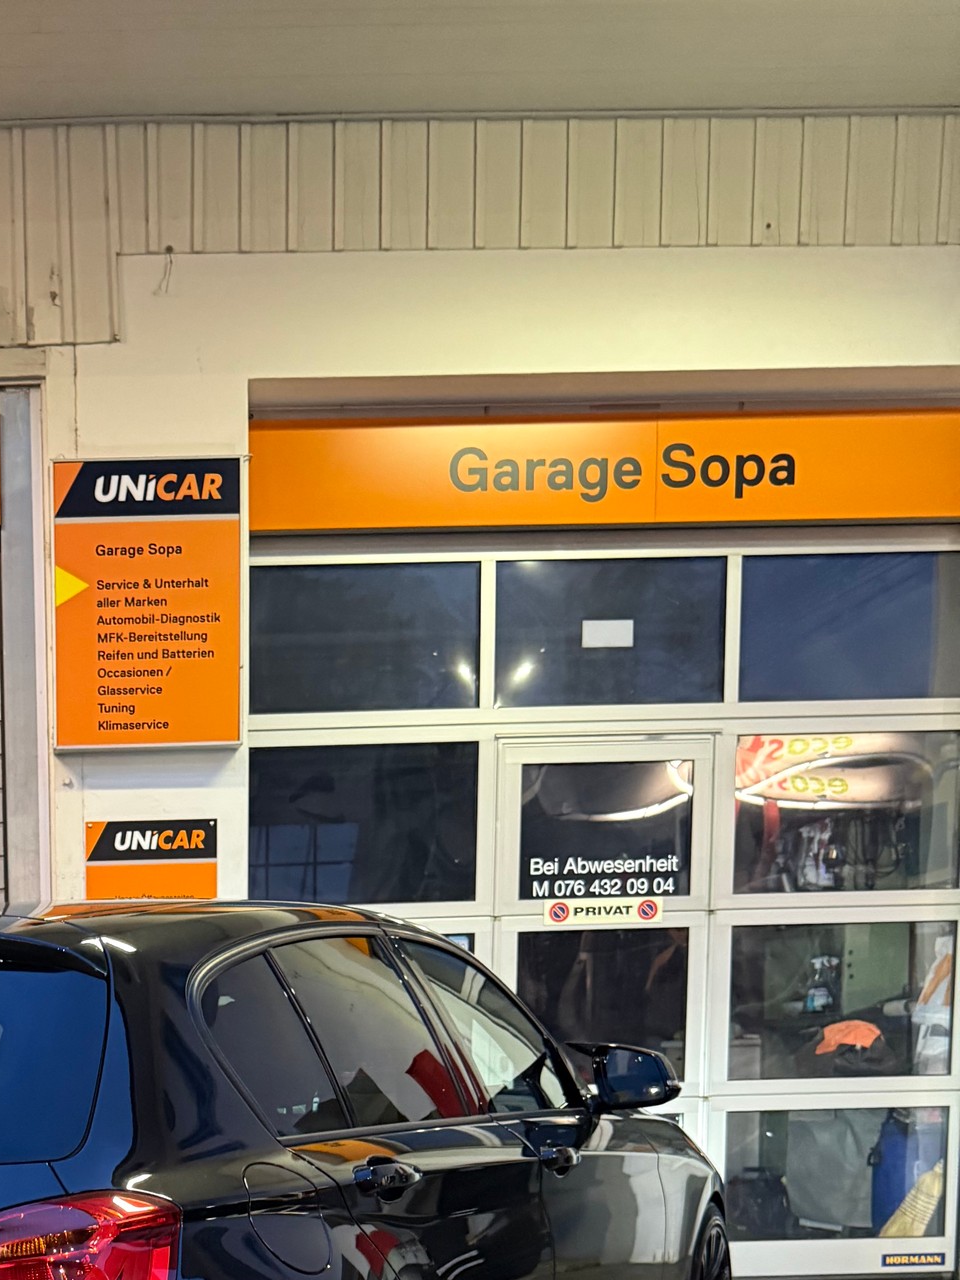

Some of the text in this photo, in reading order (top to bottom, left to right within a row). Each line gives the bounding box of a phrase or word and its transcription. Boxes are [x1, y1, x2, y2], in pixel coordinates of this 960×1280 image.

[449, 443, 797, 502] Garage Sopa
[95, 543, 183, 558] Garage Sopa
[96, 578, 209, 591] Service & Unterhalt
[96, 597, 168, 608] aller Marken
[96, 612, 221, 628] Automobil-Diagnostik
[97, 631, 208, 645] MFK-Bereitstellung
[97, 649, 215, 661] Reifen und Batterien
[97, 666, 172, 679] Occasionen /
[97, 685, 163, 697] Glasservice
[97, 703, 136, 716] Tuning
[97, 719, 170, 731] Klimaservice
[529, 854, 679, 876] Bei Abwesenheit
[532, 877, 675, 898] M 076 432 09 04
[573, 905, 633, 917] PRIVAT
